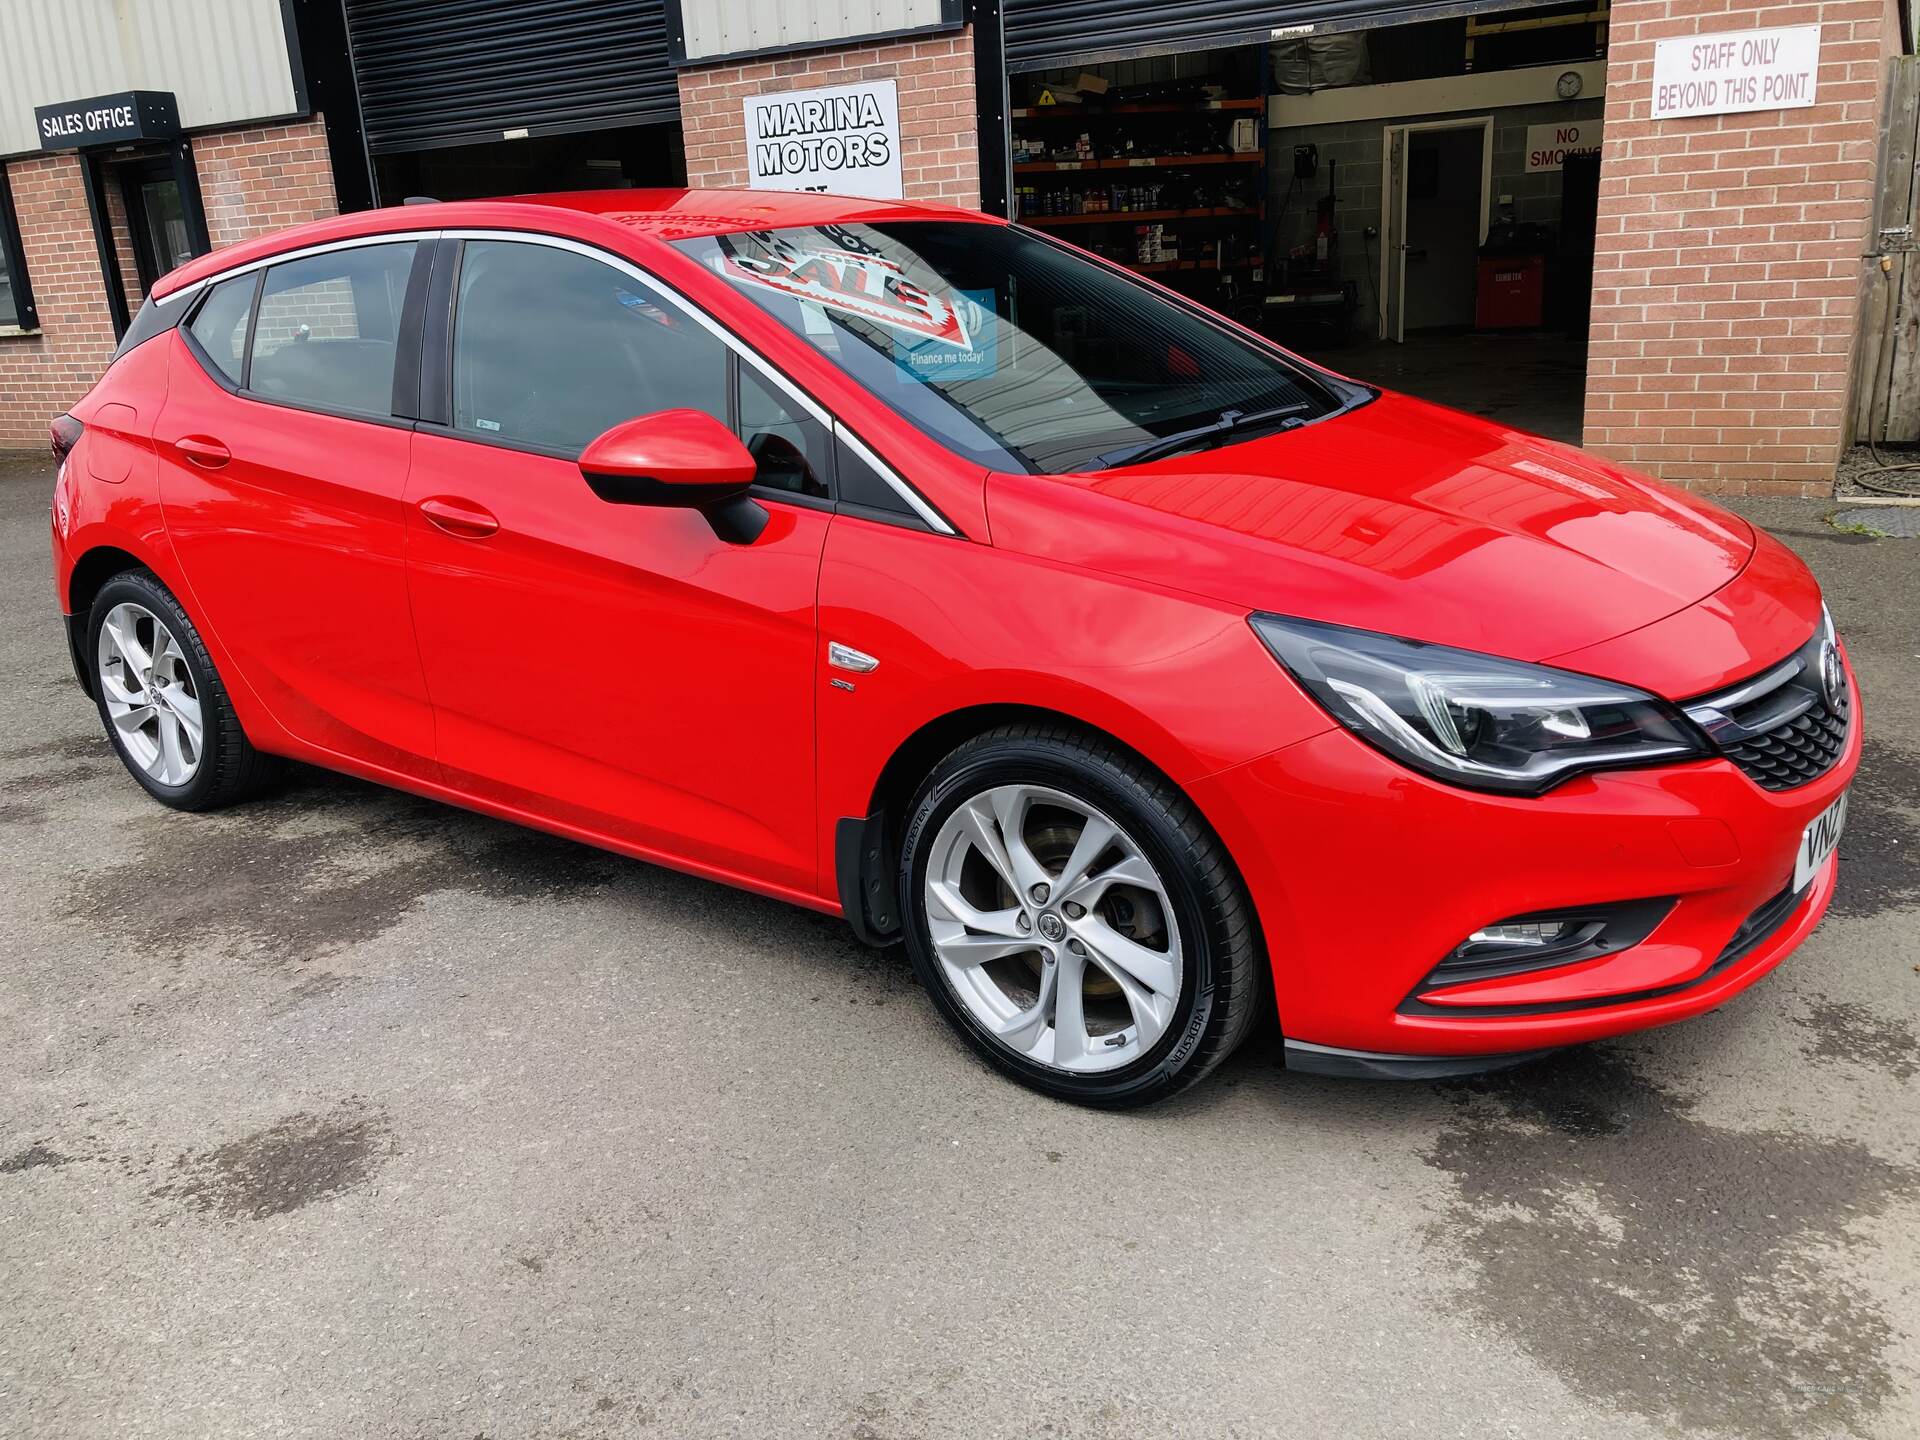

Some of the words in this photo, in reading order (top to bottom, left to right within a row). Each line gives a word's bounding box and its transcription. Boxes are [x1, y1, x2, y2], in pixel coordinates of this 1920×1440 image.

[1691, 41, 1737, 71] STAFF
[1742, 37, 1780, 67] ONLY
[1658, 80, 1718, 111] BEYOND
[1724, 75, 1757, 104] THIS
[1763, 72, 1810, 102] POINT
[42, 113, 84, 138] SALES
[85, 106, 135, 132] OFFICE
[757, 94, 884, 139] MARINA
[1556, 127, 1580, 144] NO
[756, 132, 890, 177] MOTORS
[910, 352, 942, 365] Finance
[944, 353, 957, 363] me
[959, 350, 984, 364] today!
